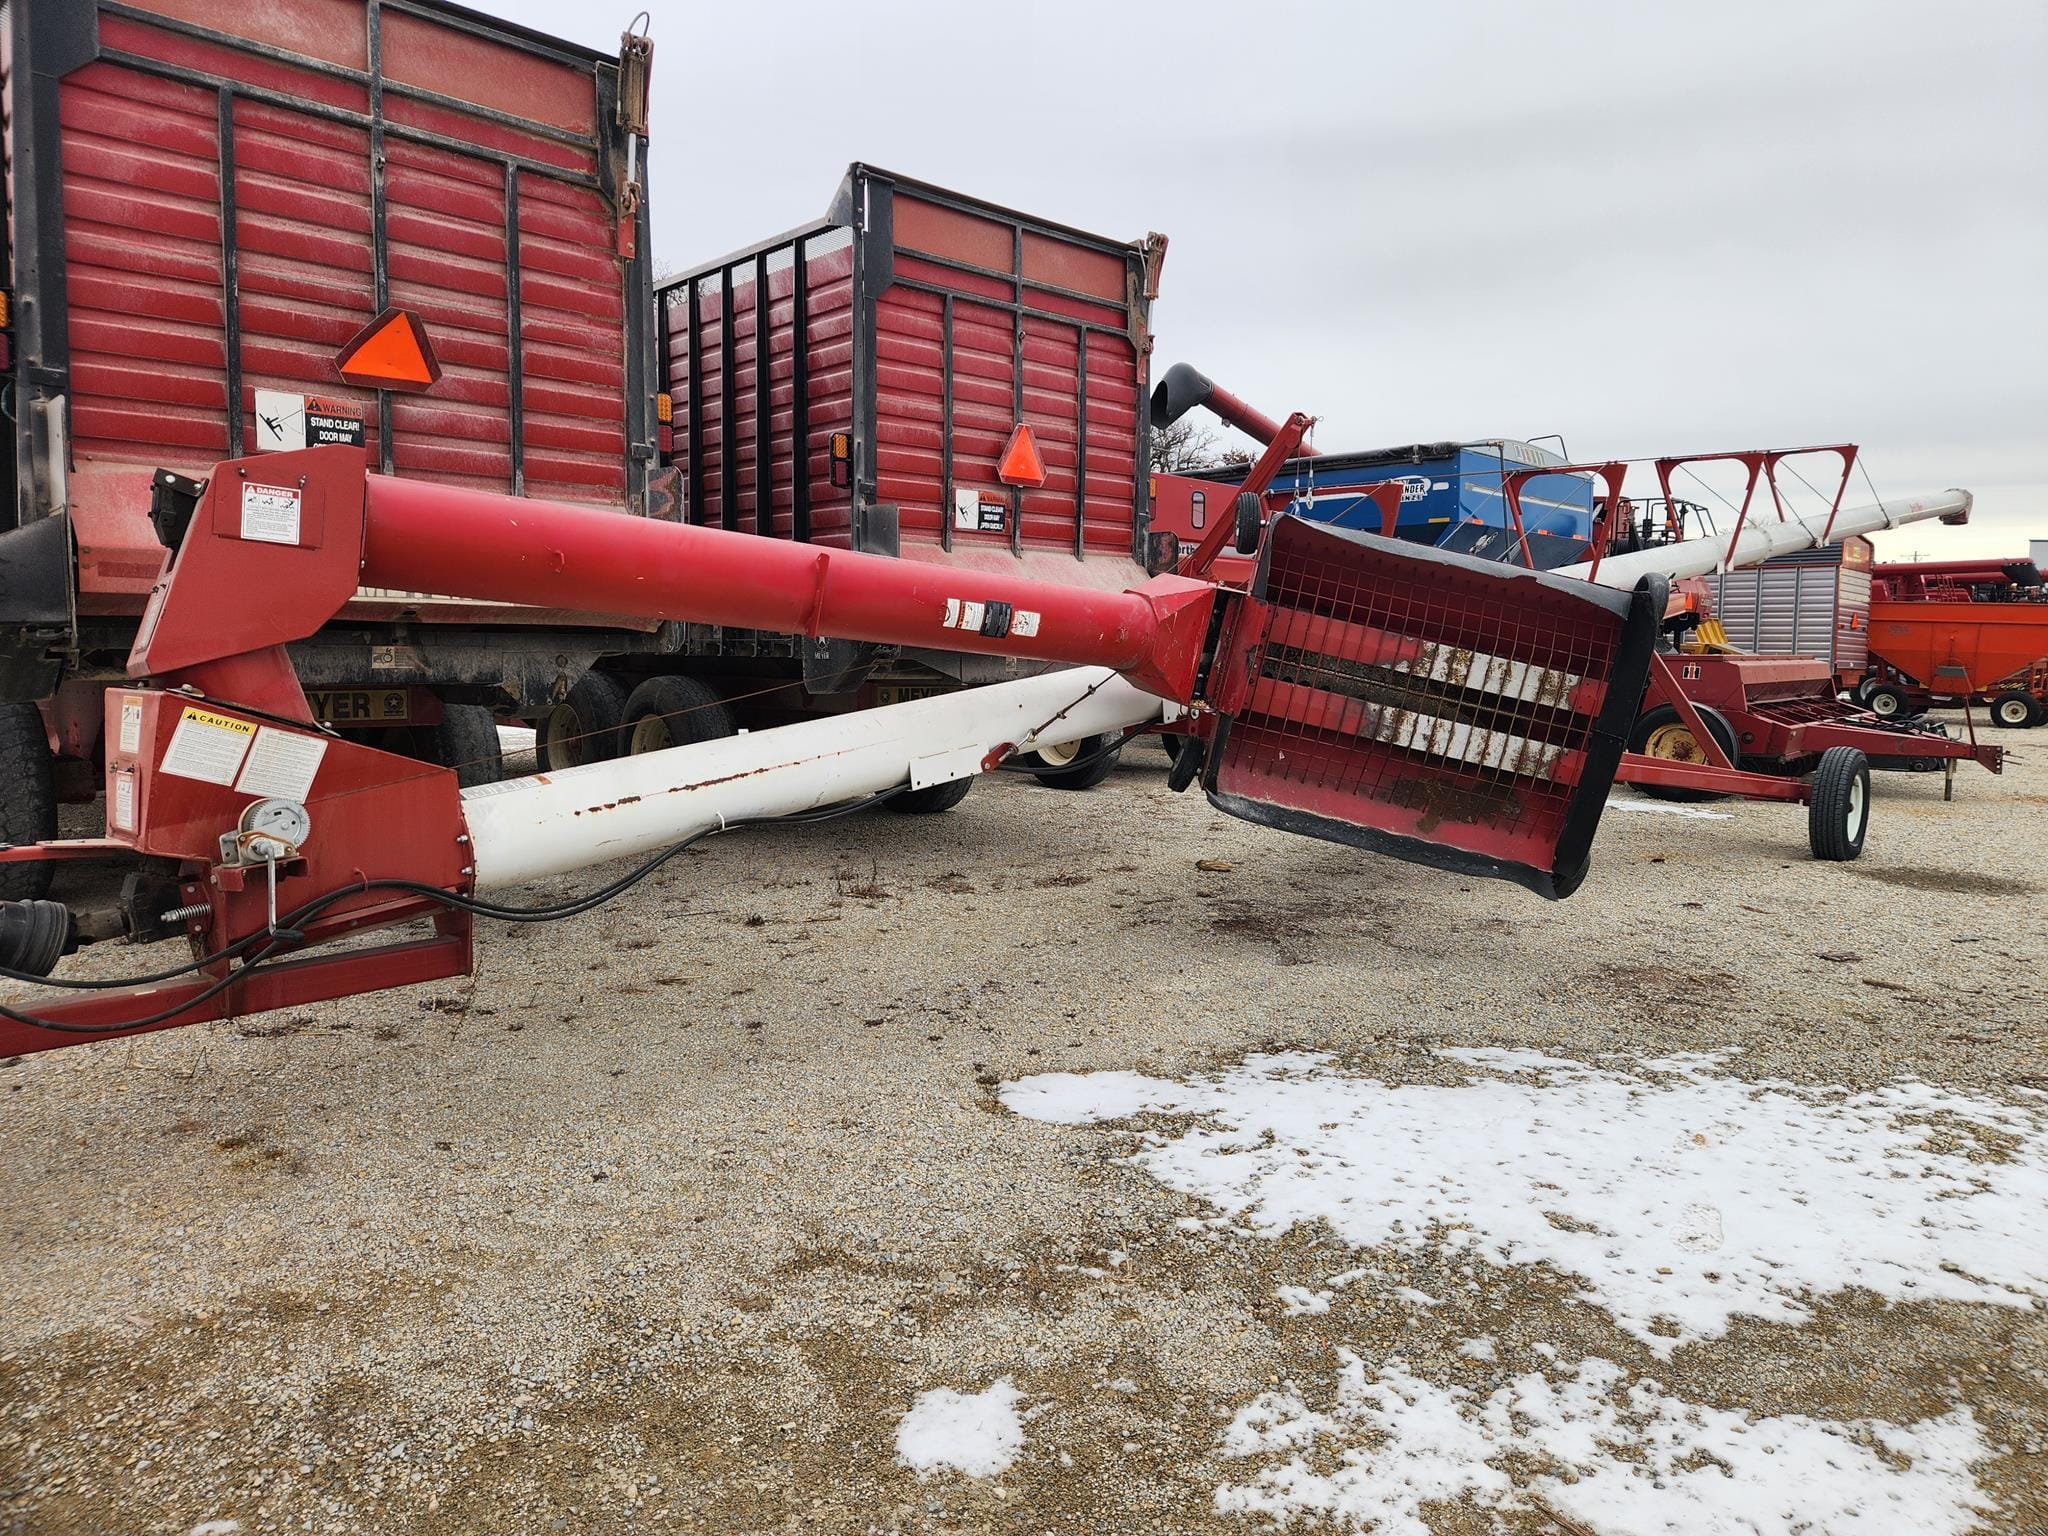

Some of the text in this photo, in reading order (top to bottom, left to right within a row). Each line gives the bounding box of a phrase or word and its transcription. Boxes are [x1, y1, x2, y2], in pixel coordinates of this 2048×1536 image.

[322, 404, 362, 417] WARNING
[310, 416, 360, 432] STAND CLEAR!
[319, 431, 353, 443] DOOR MAY
[256, 487, 294, 498] DANGER
[1402, 484, 1426, 495] NDER
[898, 687, 948, 704] MEY
[306, 692, 371, 719] YER
[199, 714, 250, 733] CAUTION
